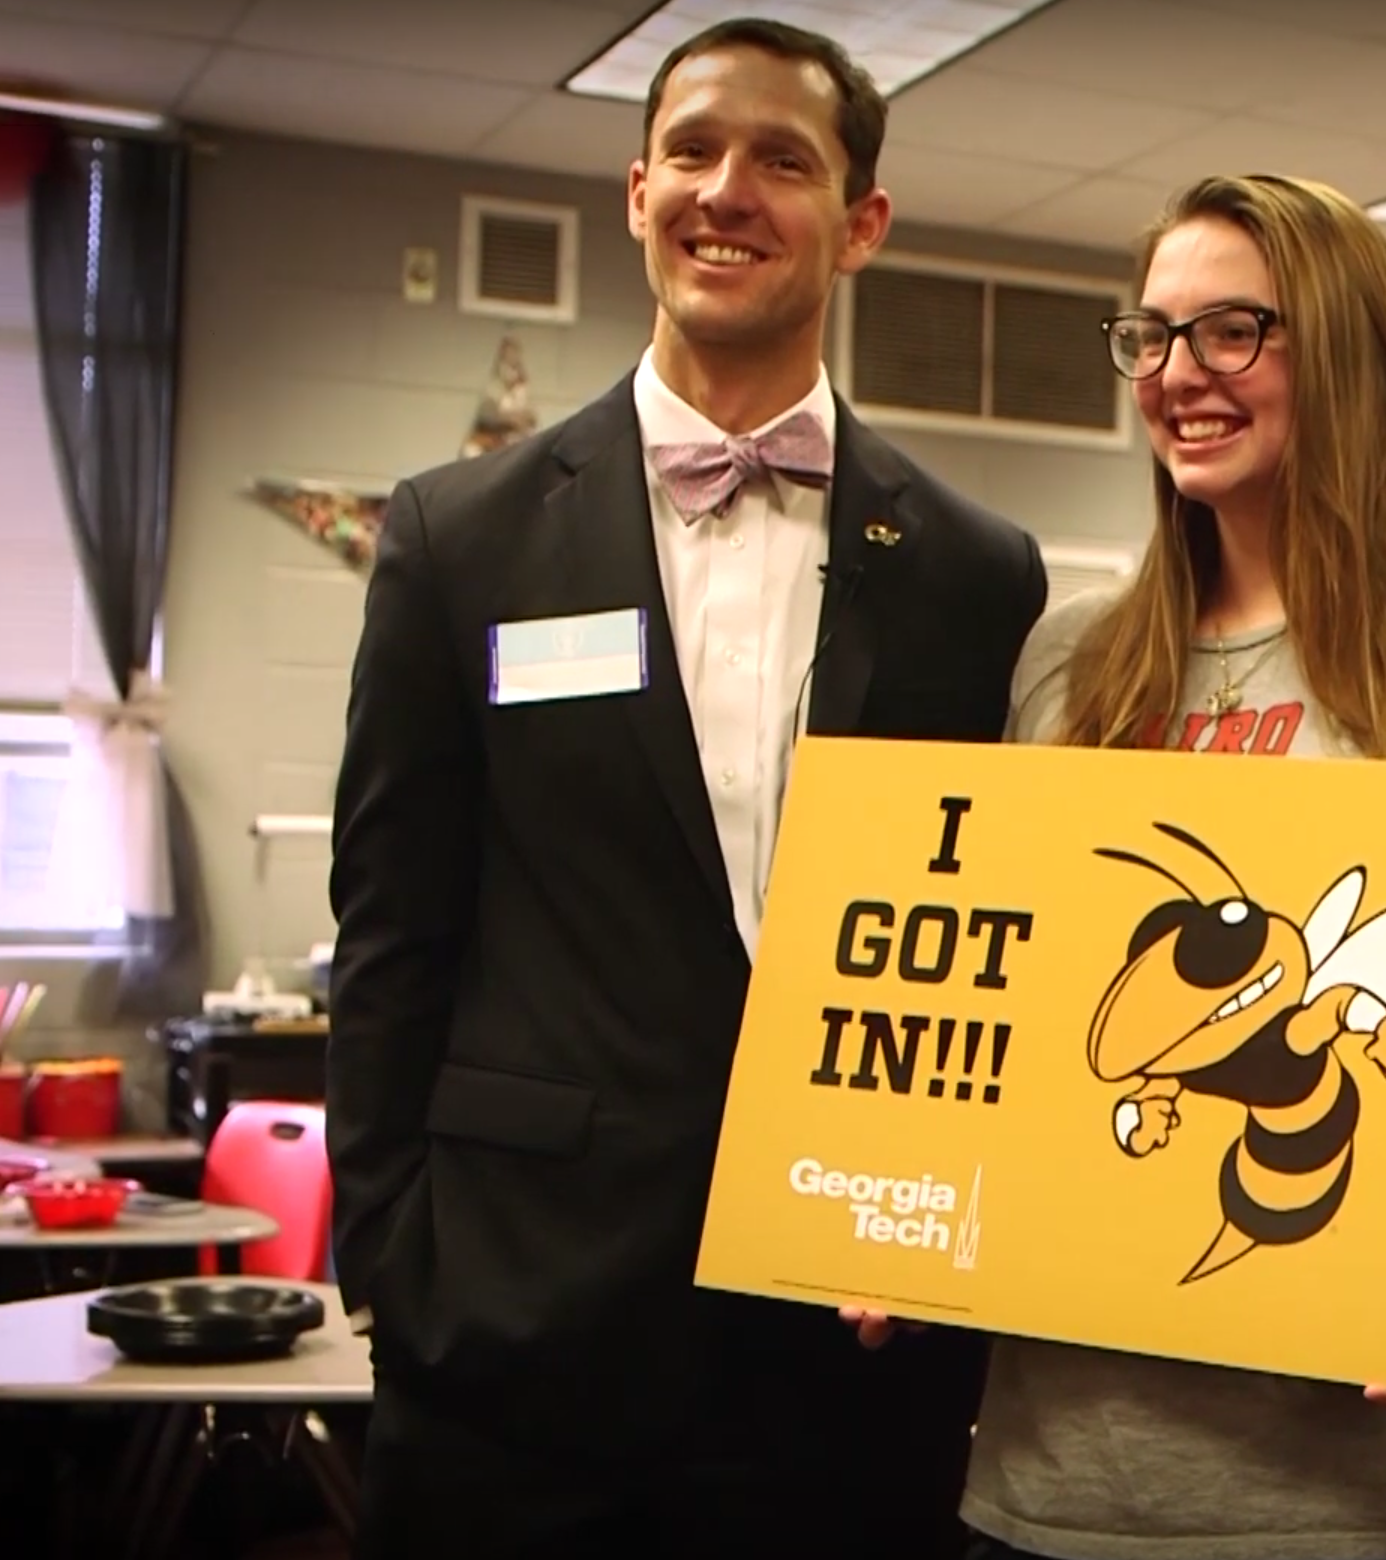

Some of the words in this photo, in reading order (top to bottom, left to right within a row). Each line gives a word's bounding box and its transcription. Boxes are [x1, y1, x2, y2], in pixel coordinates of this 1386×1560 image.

[927, 796, 972, 875] I
[835, 900, 1034, 991] GOT
[809, 1006, 1012, 1105] IN!!!
[788, 1157, 957, 1215] Georgia
[849, 1203, 951, 1251] Tech
